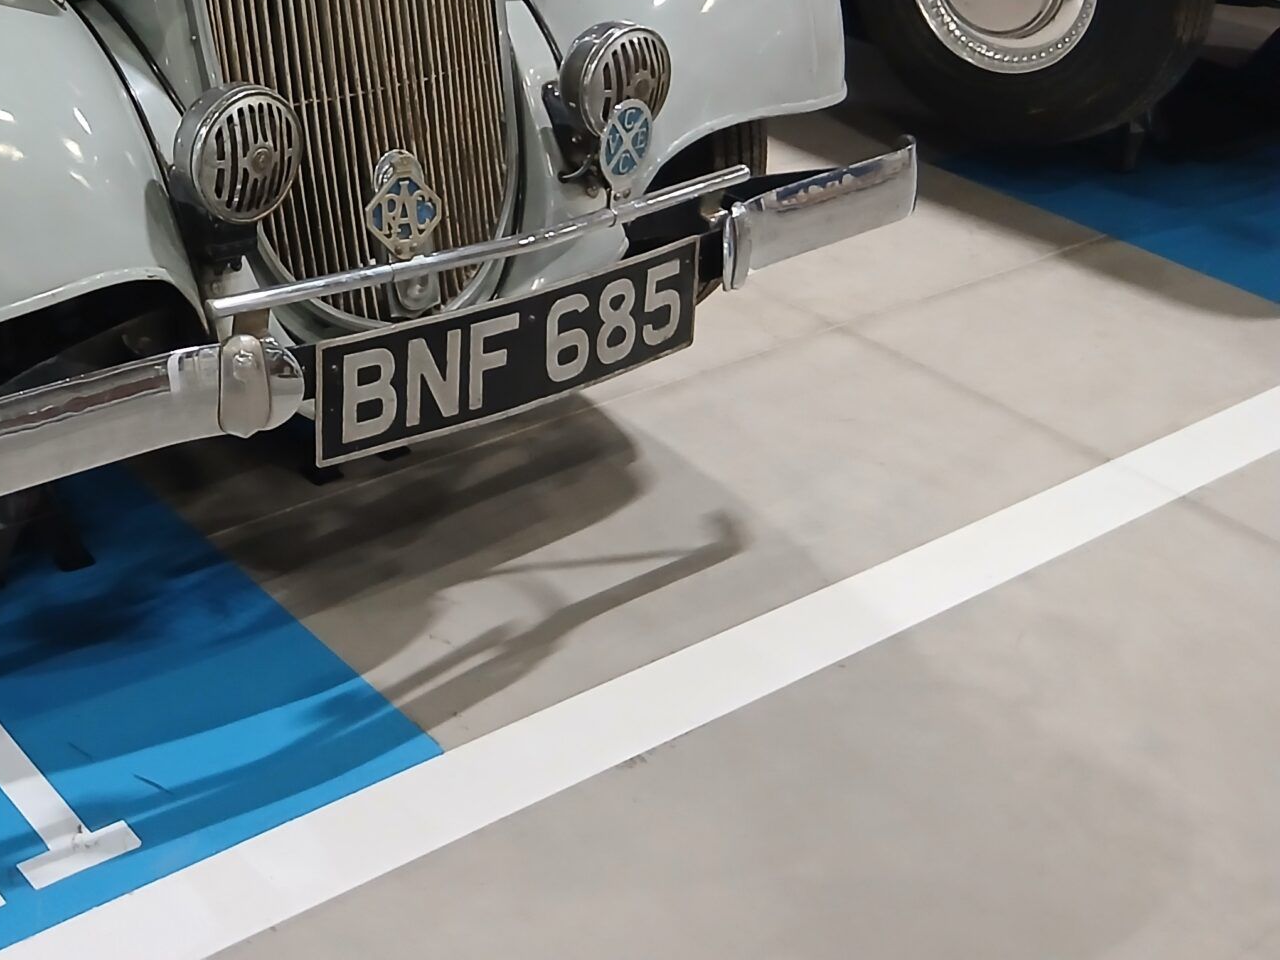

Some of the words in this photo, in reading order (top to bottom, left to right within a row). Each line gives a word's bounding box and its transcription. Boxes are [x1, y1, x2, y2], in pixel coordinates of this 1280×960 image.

[382, 180, 434, 241] RAC
[342, 311, 520, 444] BNF
[545, 258, 681, 383] 685
